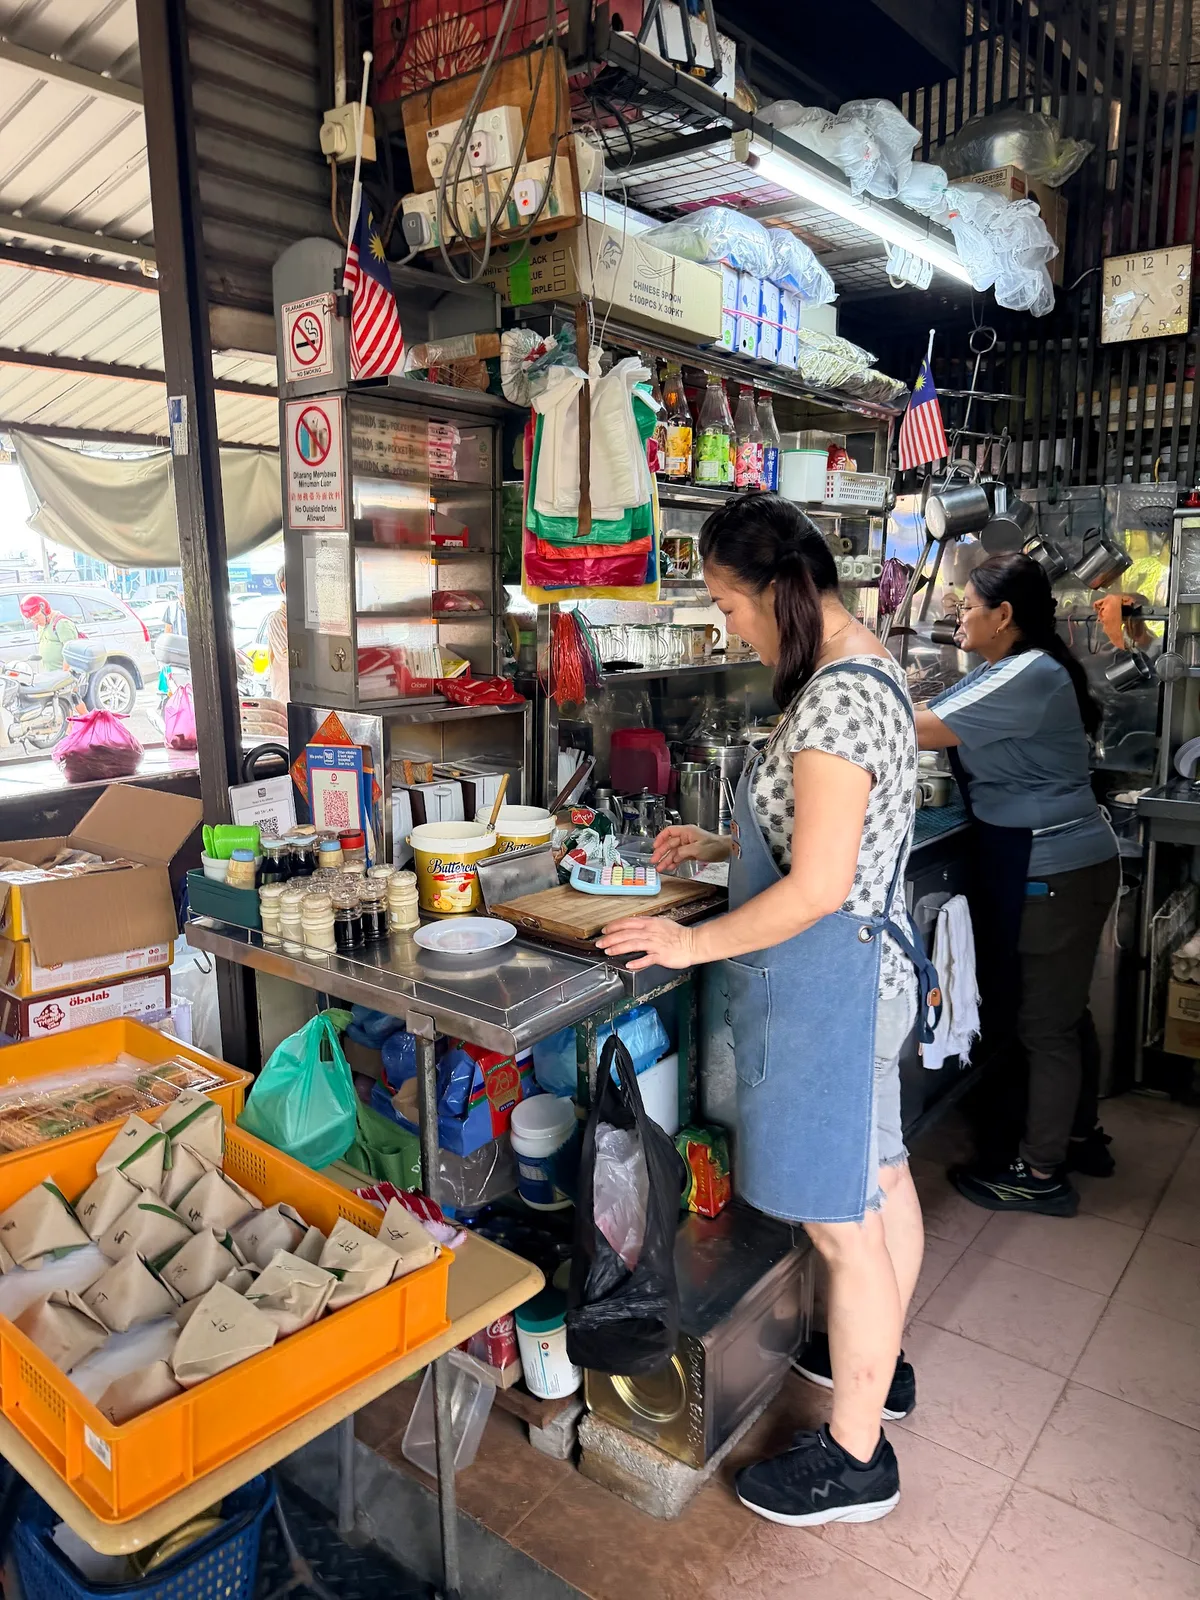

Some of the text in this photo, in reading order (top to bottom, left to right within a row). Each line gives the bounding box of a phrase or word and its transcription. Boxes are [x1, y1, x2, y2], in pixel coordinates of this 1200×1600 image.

[530, 255, 547, 266] ACK
[1126, 260, 1135, 271] 11
[1142, 257, 1154, 269] 12
[1177, 264, 1185, 276] 2
[1111, 275, 1121, 287] 10
[531, 284, 553, 295] URPLE
[633, 280, 682, 304] CHINESE SPOON
[1176, 284, 1184, 297] 3
[285, 301, 305, 313] DILARANG
[664, 305, 683, 318] 30PKT
[1175, 305, 1182, 316] 4
[1126, 324, 1133, 336] 7
[1142, 322, 1149, 333] 6
[1158, 319, 1166, 331] 5
[303, 367, 322, 376] SMOKING
[293, 471, 337, 480] Dilarang Membawa
[298, 480, 320, 488] Minuman
[69, 990, 110, 1007] öbalab
